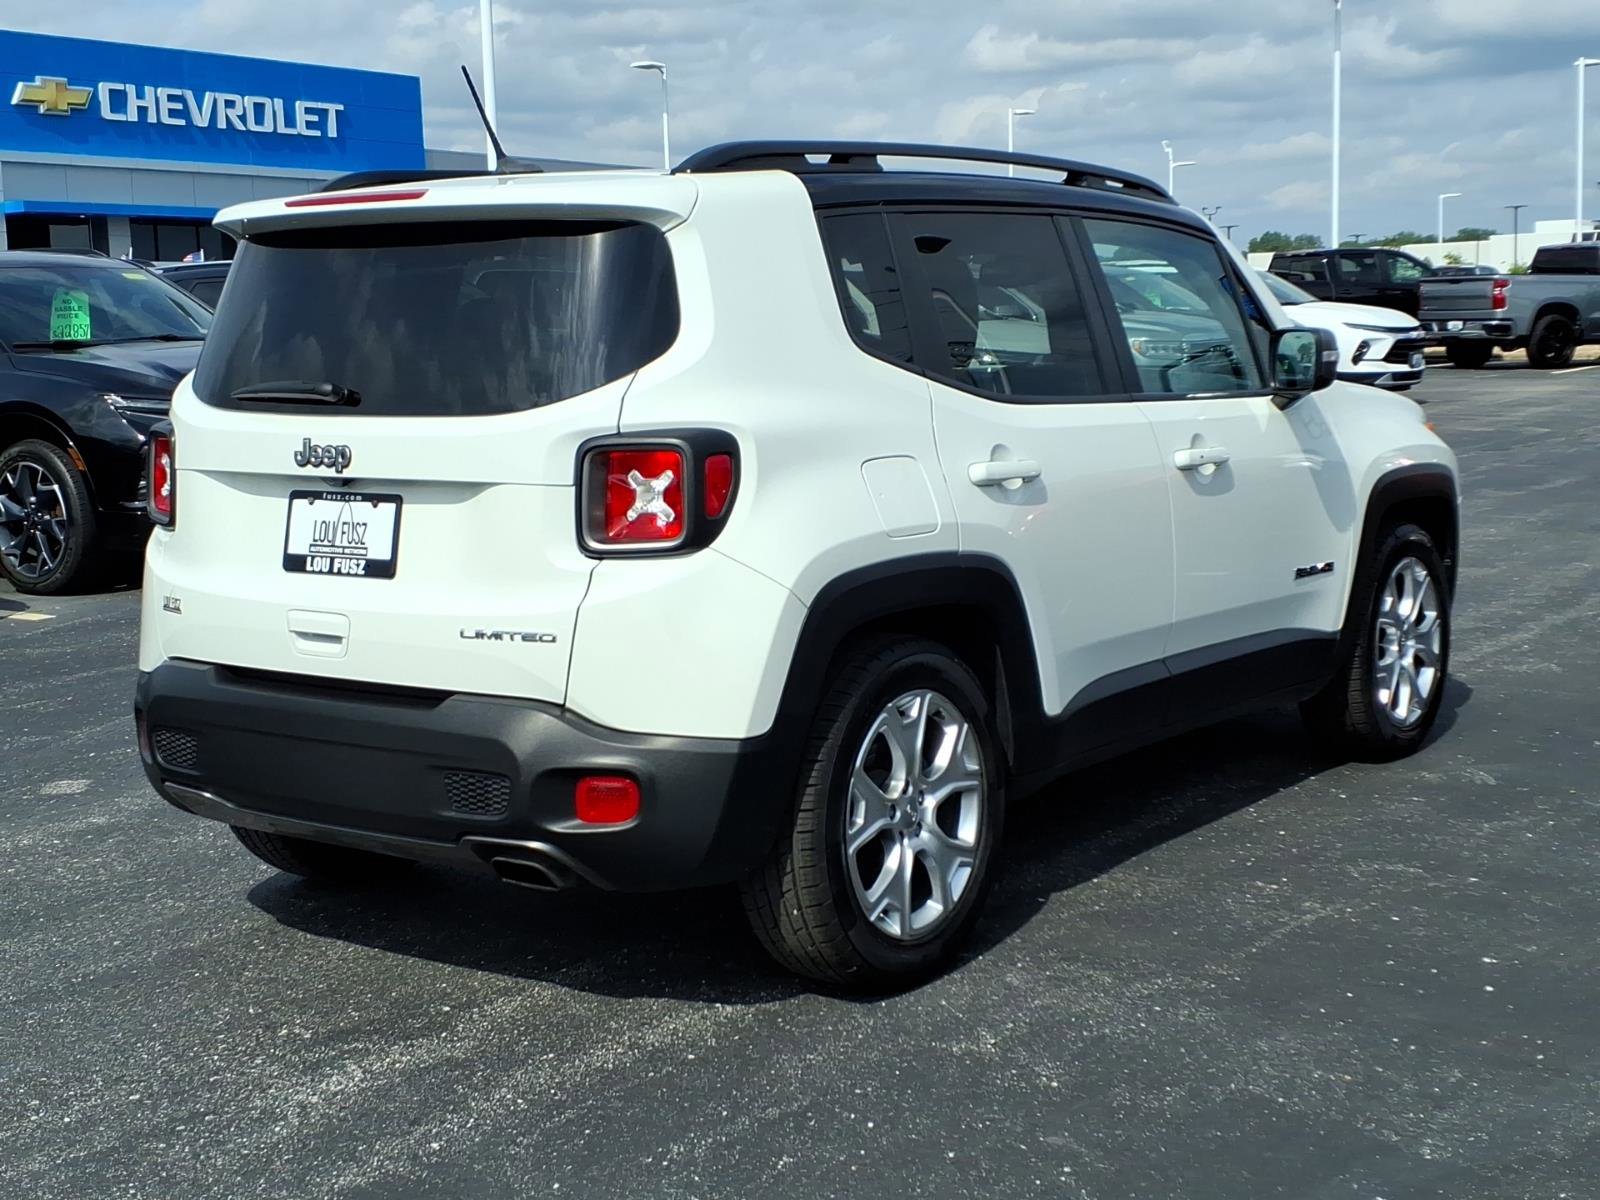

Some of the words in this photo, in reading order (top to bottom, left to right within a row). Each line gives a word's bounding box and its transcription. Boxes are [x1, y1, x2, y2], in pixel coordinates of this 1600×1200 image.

[98, 81, 344, 138] CHEVROLET
[294, 437, 352, 474] Jeep
[322, 492, 362, 501] fusz.com
[312, 519, 336, 543] LOU
[340, 521, 368, 545] FUSZ
[306, 556, 331, 573] LOU
[333, 558, 366, 575] FUSZ
[460, 628, 557, 643] LIMITED
